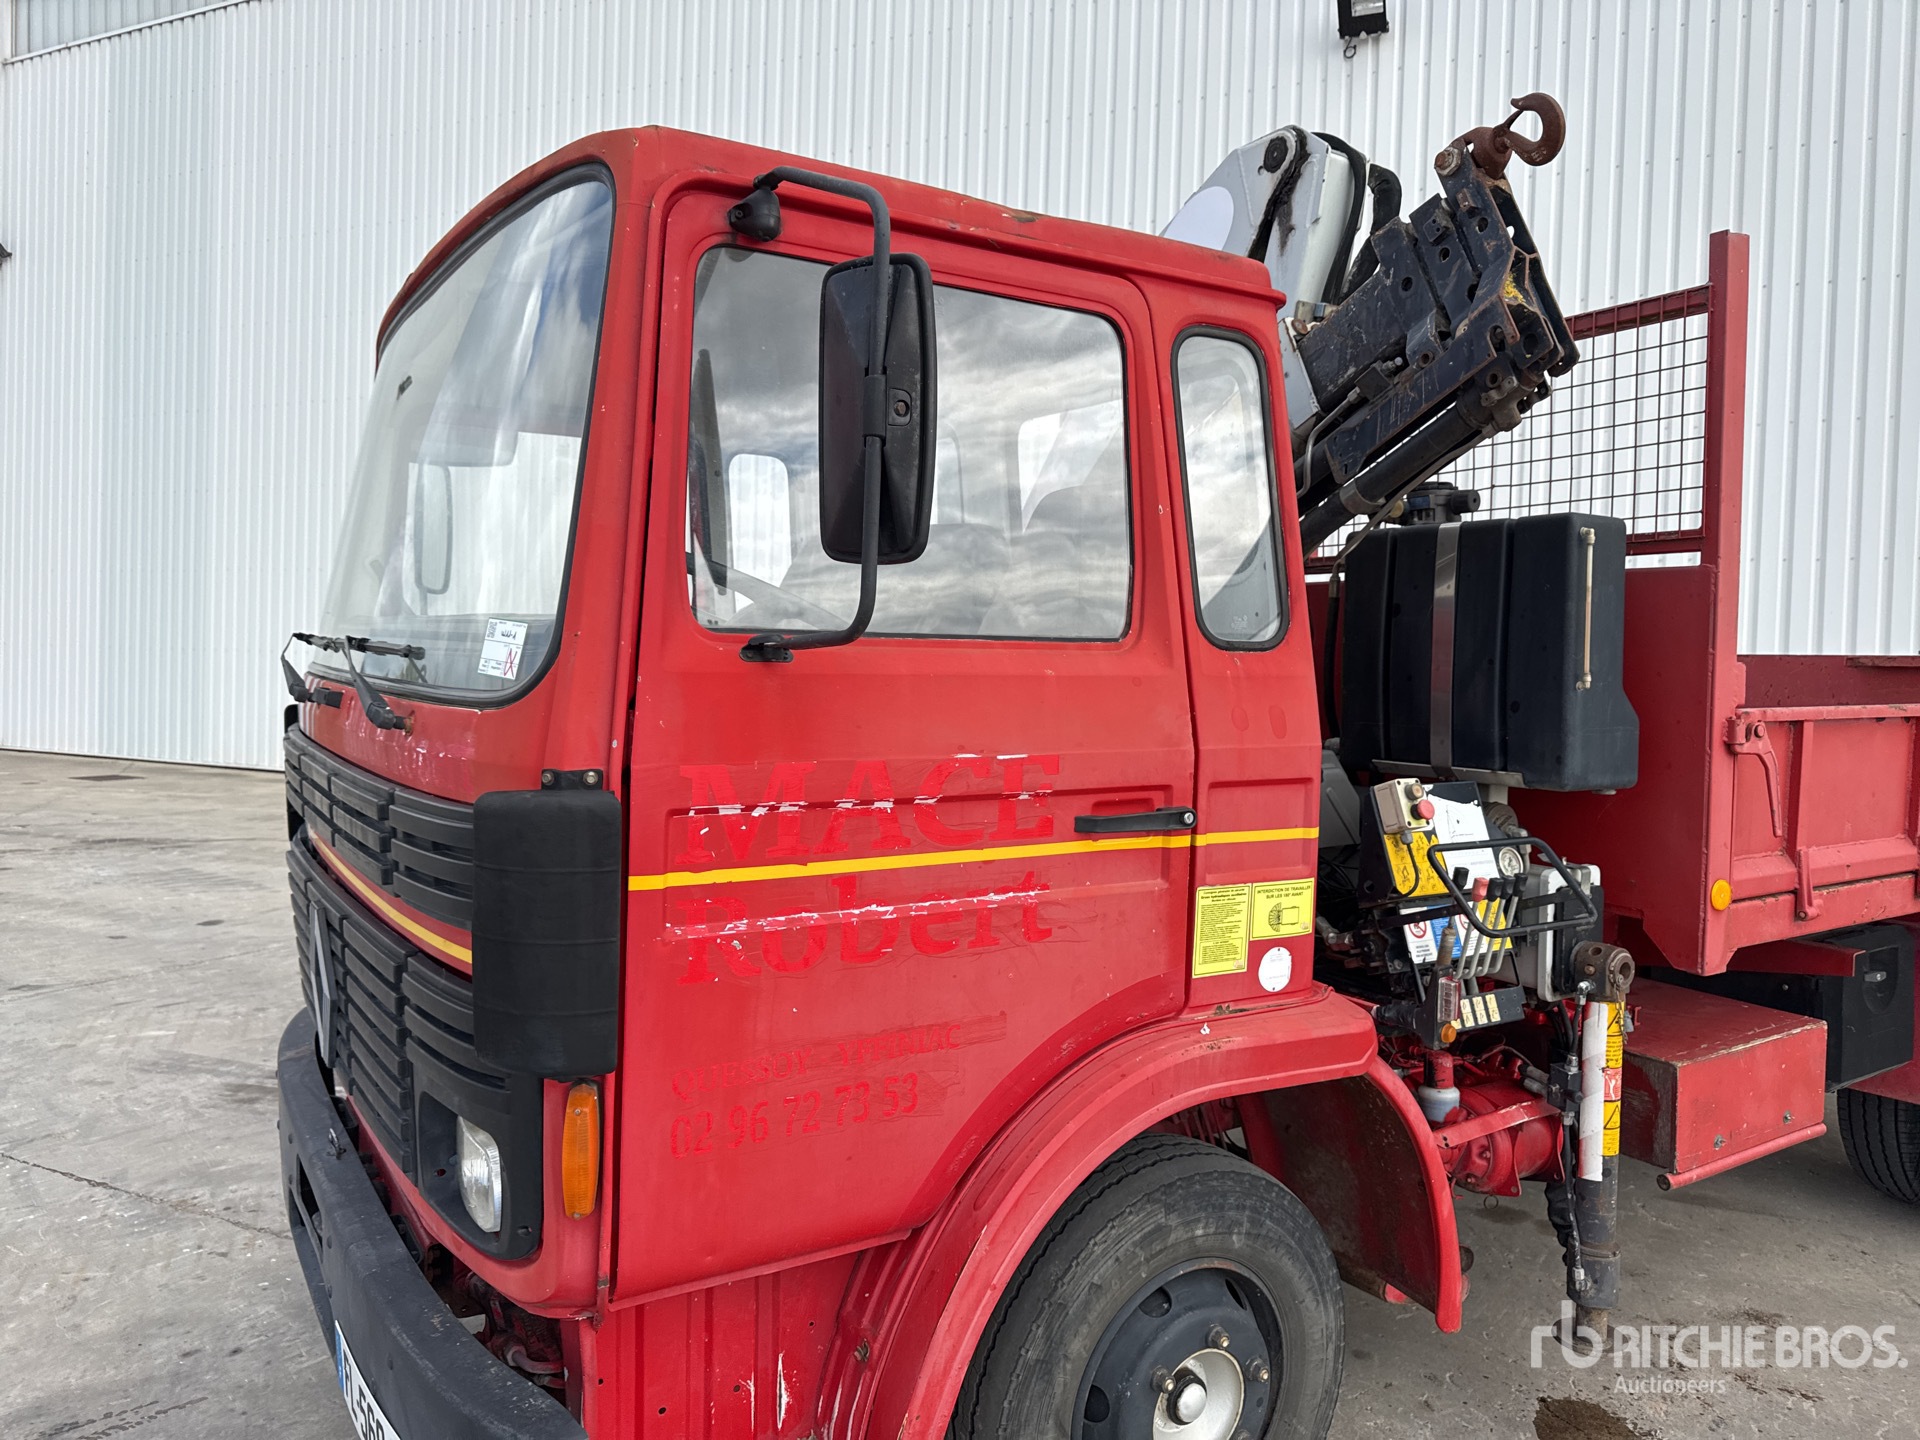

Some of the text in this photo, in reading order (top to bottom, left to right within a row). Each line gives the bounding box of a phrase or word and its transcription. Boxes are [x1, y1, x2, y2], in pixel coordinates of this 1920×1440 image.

[676, 755, 1060, 865] MACE
[676, 872, 1054, 985] Robert
[670, 1071, 919, 1160] 02 96 72 73 53
